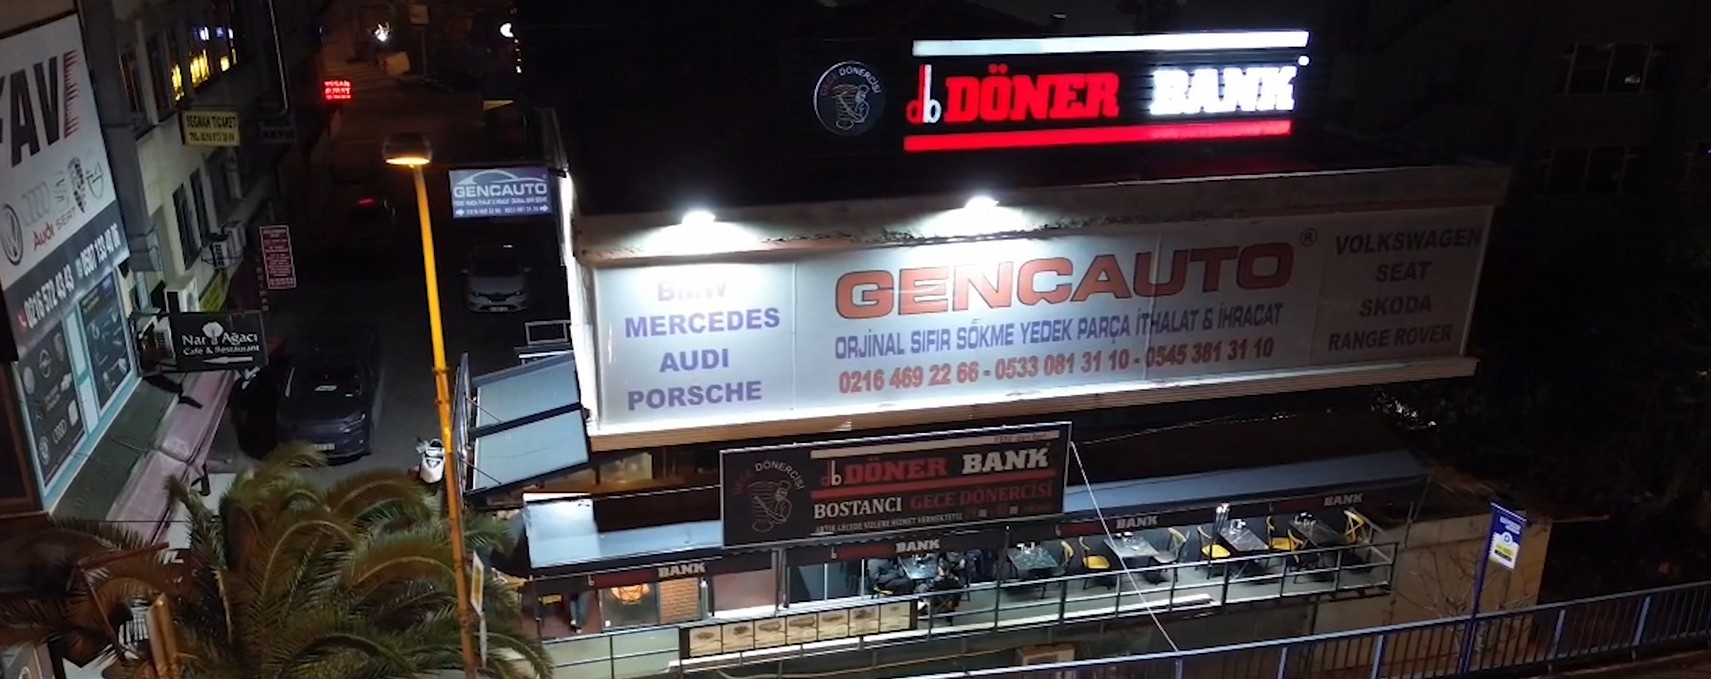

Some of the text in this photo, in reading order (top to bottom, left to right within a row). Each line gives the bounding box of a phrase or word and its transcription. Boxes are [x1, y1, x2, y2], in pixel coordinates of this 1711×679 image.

[944, 63, 1120, 123] DÖNER
[1148, 65, 1297, 116] BANK
[33, 222, 55, 252] Audi
[1335, 228, 1483, 255] VOLKSWAGEN
[1375, 261, 1432, 283] SEAT
[1358, 294, 1432, 318] SKODA
[624, 307, 781, 339] MERCEDES
[835, 328, 905, 359] ORJİNAL
[910, 326, 950, 354] SIFIR
[956, 318, 1014, 350] SÖKME
[1020, 317, 1074, 345] YEDEK
[1077, 314, 1131, 344] PARÇA
[1135, 307, 1199, 335] İTHALAT
[1217, 301, 1284, 328] İHRACAT
[181, 334, 207, 346] Nar
[1327, 324, 1454, 352] RANGE ROVER
[659, 348, 730, 373] AUDI
[839, 368, 885, 394] 0216
[889, 365, 924, 390] 469
[927, 362, 952, 387] 22
[956, 360, 980, 384] 66
[994, 354, 1039, 381] 0533
[1043, 351, 1076, 376] 081
[1081, 350, 1103, 373] 31
[1108, 347, 1130, 371] 10
[1145, 344, 1187, 368] 0545
[1191, 339, 1223, 364] 381
[1228, 337, 1248, 362] 31
[1253, 335, 1275, 359] 10
[627, 380, 763, 411] PORSCHE
[844, 457, 948, 485] DÖNER
[961, 446, 1049, 475] BANK
[813, 495, 902, 520] BOSTANCI
[910, 491, 954, 510] GECE
[1322, 492, 1364, 507] BANK
[1115, 515, 1159, 530] BANK
[895, 538, 941, 554] BANK
[656, 561, 707, 579] BANK
